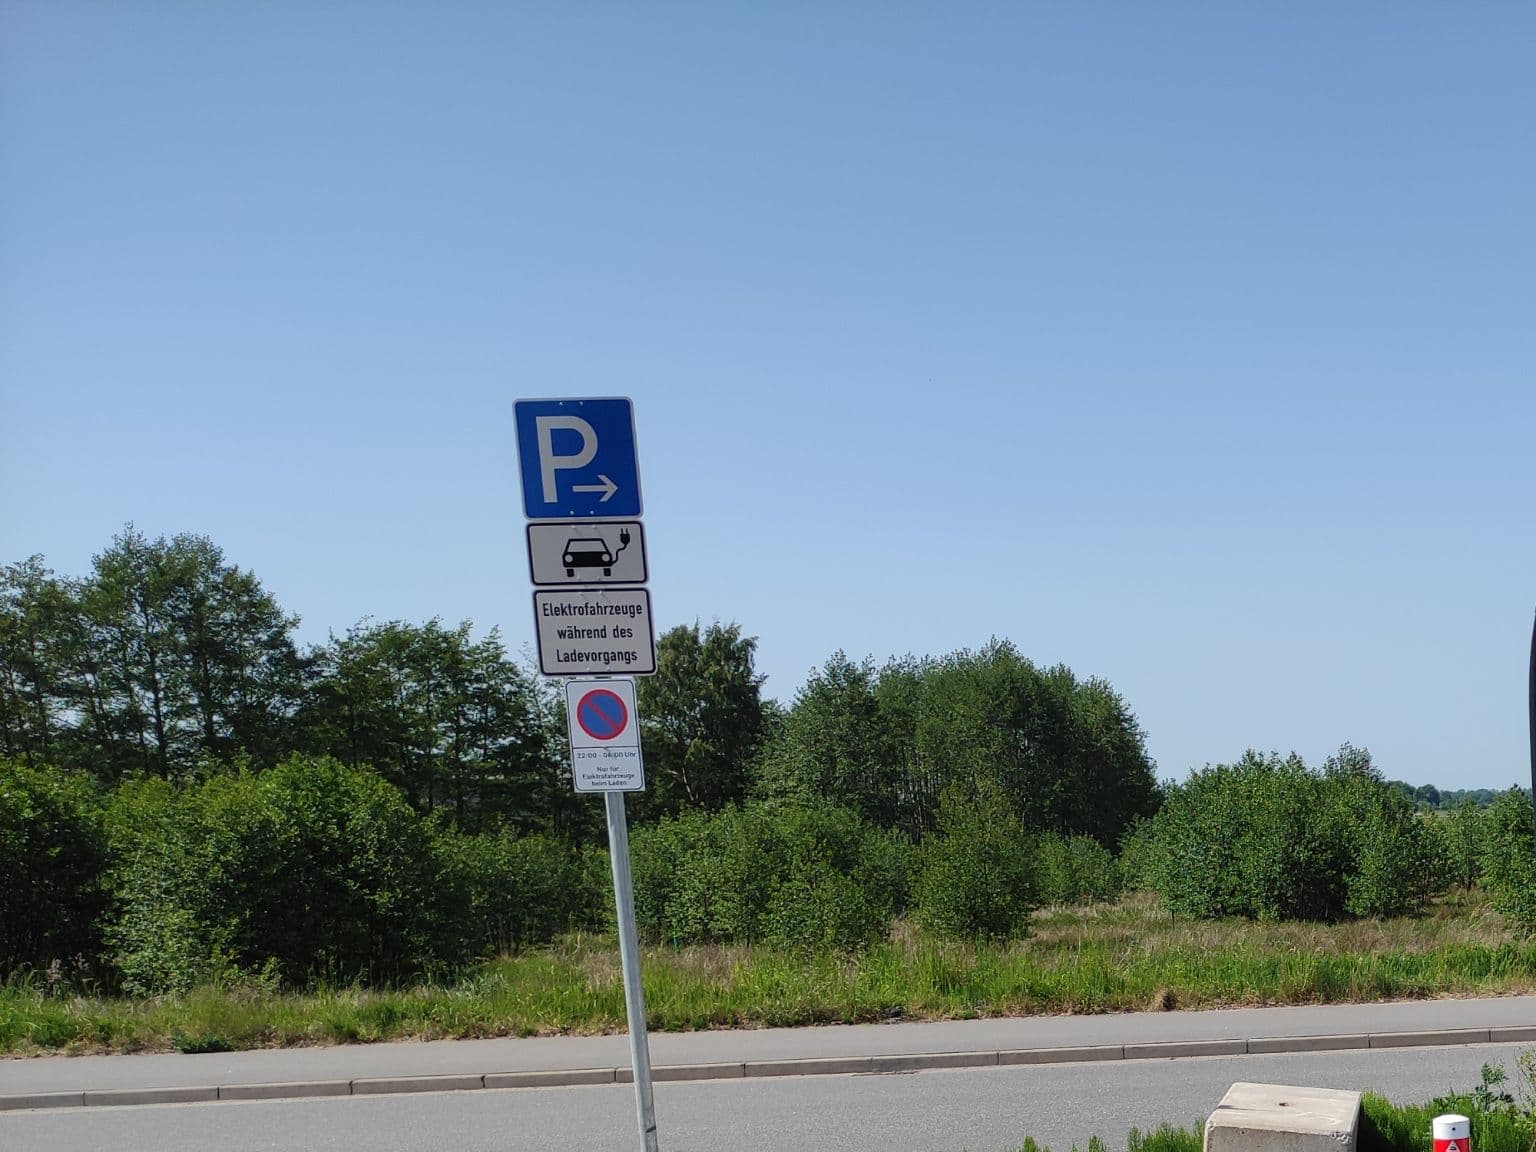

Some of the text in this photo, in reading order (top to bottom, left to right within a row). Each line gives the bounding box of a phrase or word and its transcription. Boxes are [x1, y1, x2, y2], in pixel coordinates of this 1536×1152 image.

[535, 416, 598, 503] P
[542, 602, 643, 619] Elektrofahrzeuge
[557, 624, 633, 639] während des
[557, 647, 637, 665] Ladevorgangs
